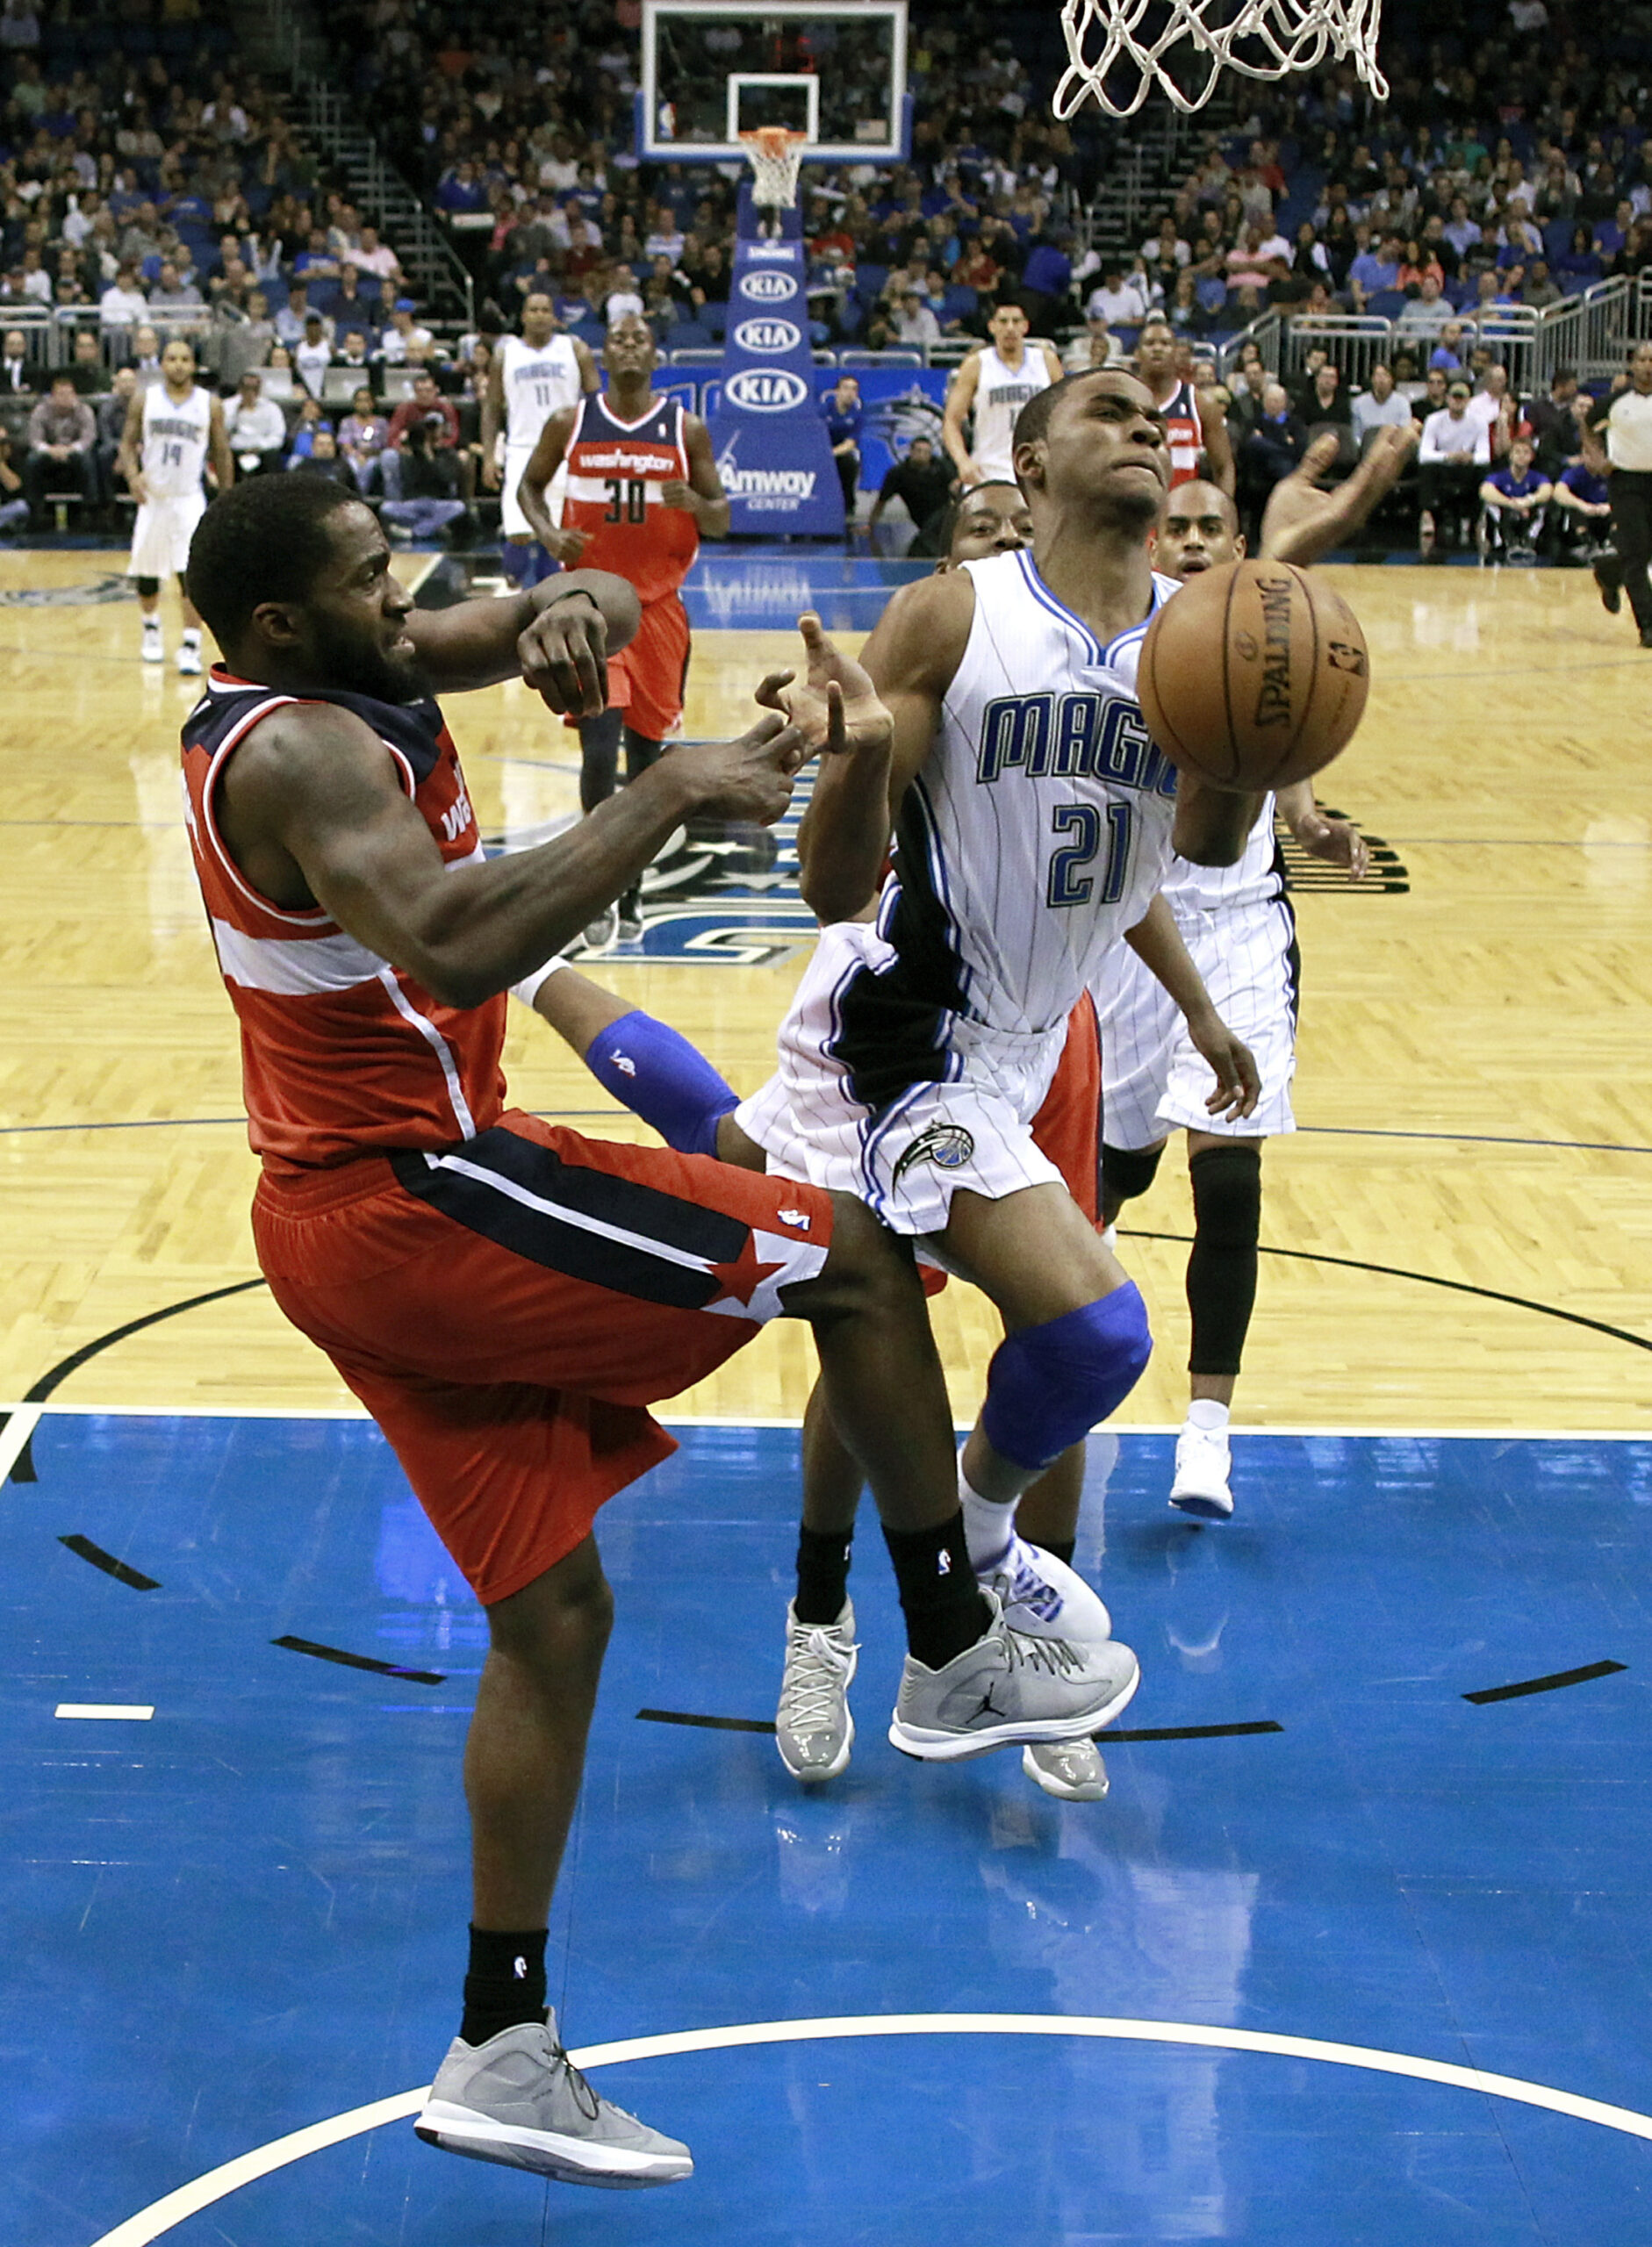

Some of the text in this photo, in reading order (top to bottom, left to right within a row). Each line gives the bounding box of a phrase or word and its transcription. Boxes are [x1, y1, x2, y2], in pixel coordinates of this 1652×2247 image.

[749, 276, 788, 295] KIA
[747, 326, 789, 346] KIA
[740, 377, 794, 403] KIA
[720, 465, 816, 499] Amway
[605, 479, 645, 524] 30
[748, 498, 800, 511] CENTER
[1253, 578, 1293, 728] SPALDING
[1047, 802, 1131, 908] 21
